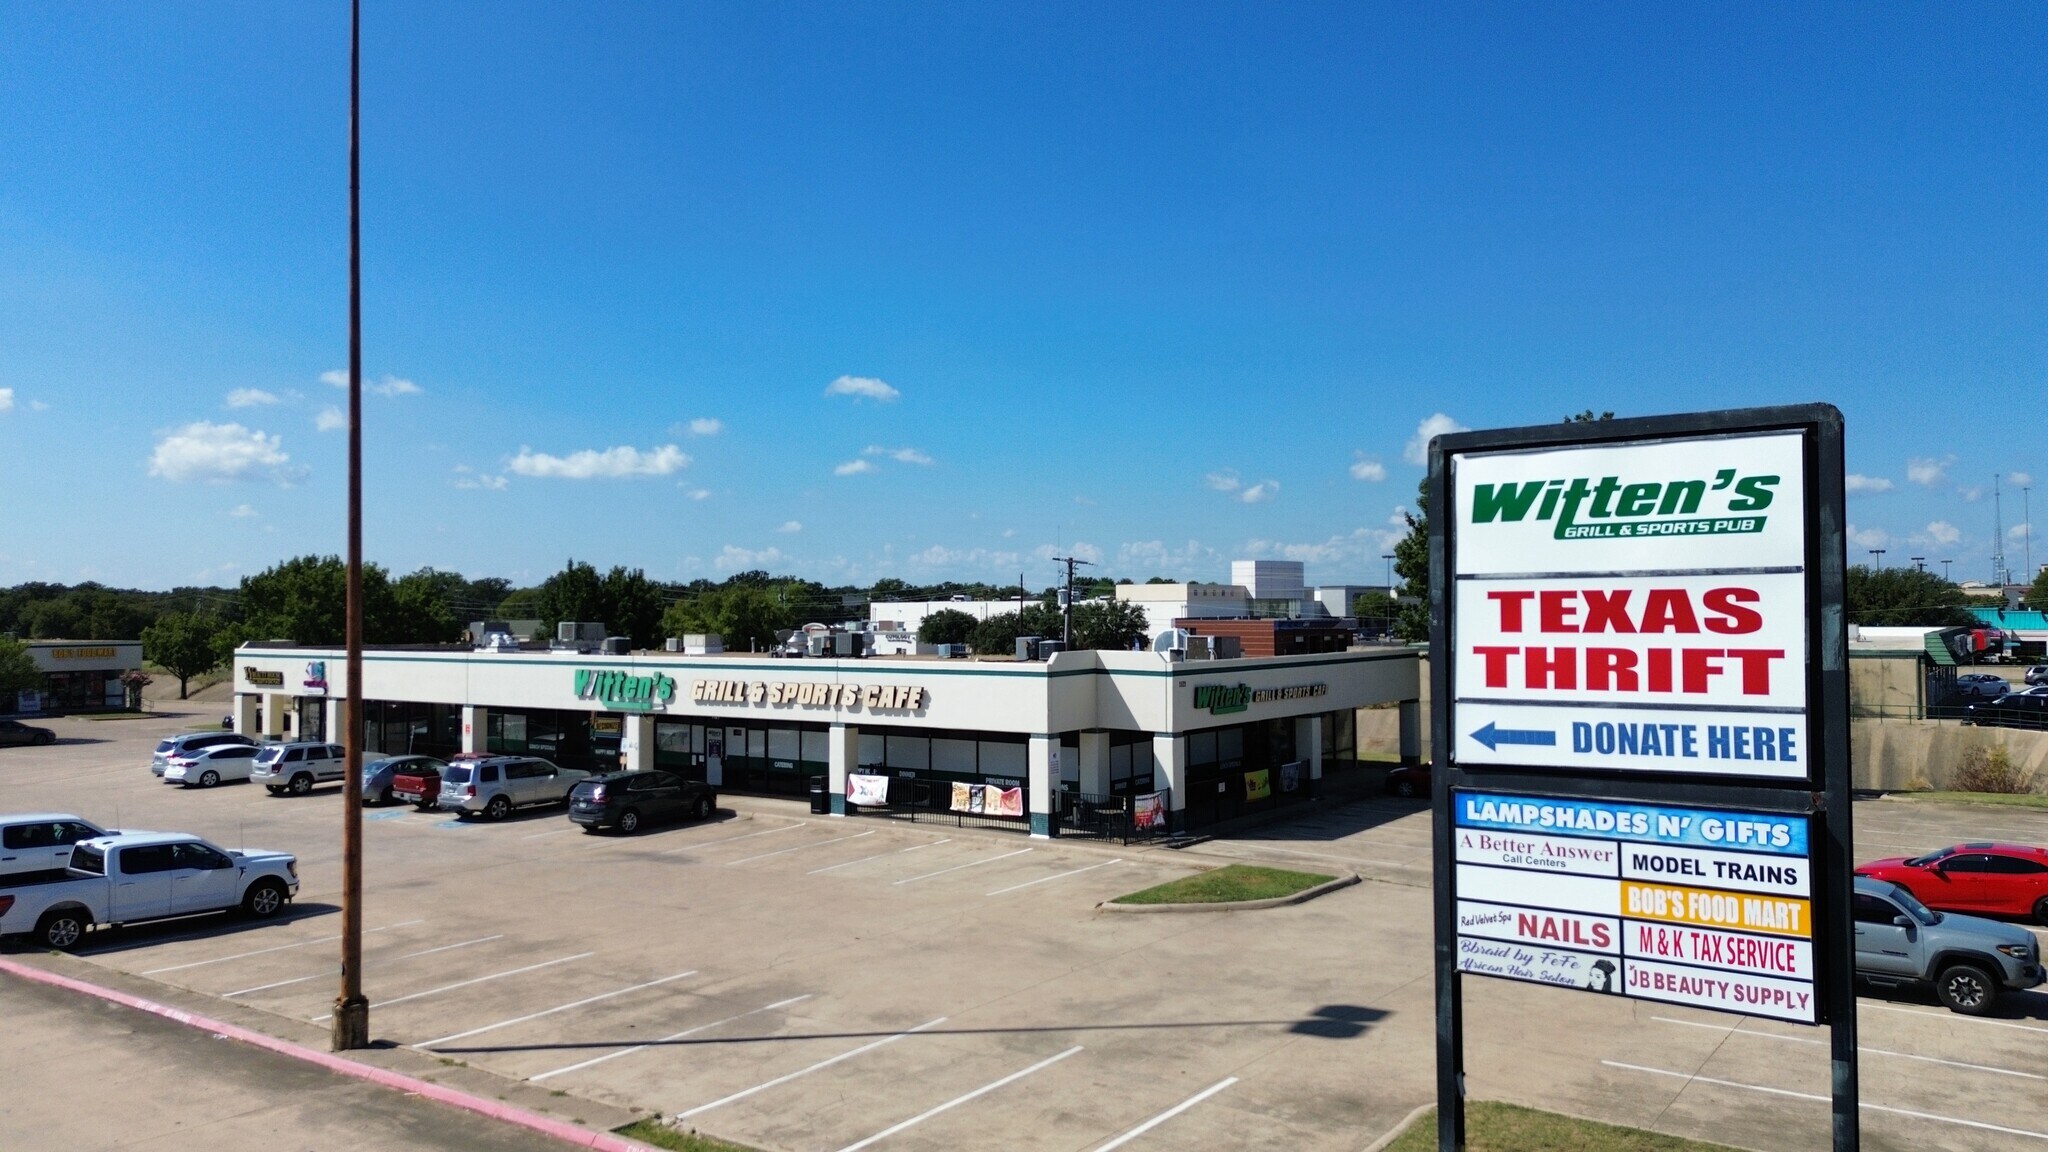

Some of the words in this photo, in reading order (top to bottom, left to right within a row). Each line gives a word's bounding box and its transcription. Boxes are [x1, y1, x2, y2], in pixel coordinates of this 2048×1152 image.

[1472, 469, 1781, 539] Witten's
[1564, 525, 1615, 538] GRILL
[1619, 524, 1632, 536] &
[1636, 521, 1710, 535] SPORTS
[1714, 519, 1755, 532] PUB
[1487, 587, 1763, 635] TEXAS
[1473, 646, 1785, 695] THRIFT
[575, 669, 673, 711] Witten's
[690, 680, 746, 701] GRILL
[750, 682, 765, 703] &
[768, 682, 858, 706] SPORTS
[862, 685, 922, 709] CAFE
[1195, 684, 1251, 714] Witten's
[1254, 690, 1275, 702] GRILL
[1283, 686, 1310, 699] SPORTS
[1572, 721, 1698, 757] DONATE
[1708, 725, 1797, 762] HERE
[1466, 800, 1649, 835] LAMPSHADES
[1658, 815, 1692, 837] N'
[1701, 818, 1791, 847] GIFTS
[1460, 834, 1473, 849] A
[1480, 835, 1536, 853] Better
[1540, 841, 1613, 862] Answer
[1502, 854, 1523, 864] Call
[1525, 855, 1567, 868] Centers
[1632, 853, 1706, 876] MODEL
[1713, 861, 1798, 885] TRAINS
[1475, 913, 1498, 925] Velvet
[1499, 911, 1512, 924] Spa
[1628, 886, 1684, 918] BOB'S
[1688, 892, 1739, 923] FOOD
[1743, 899, 1801, 931] MART
[1518, 913, 1611, 948] NAILS
[1640, 925, 1653, 954] M
[1657, 928, 1669, 956] &
[1673, 930, 1684, 958] K
[1690, 932, 1723, 964] TAX
[1727, 937, 1796, 973] SERVICE
[1459, 957, 1504, 972] African
[1506, 964, 1533, 978] Hair
[1539, 970, 1576, 985] Salon
[1513, 949, 1533, 966] by
[1540, 952, 1581, 970] FeFe
[1654, 972, 1729, 1000] BEAUTY
[1733, 983, 1810, 1011] SUPPLY
